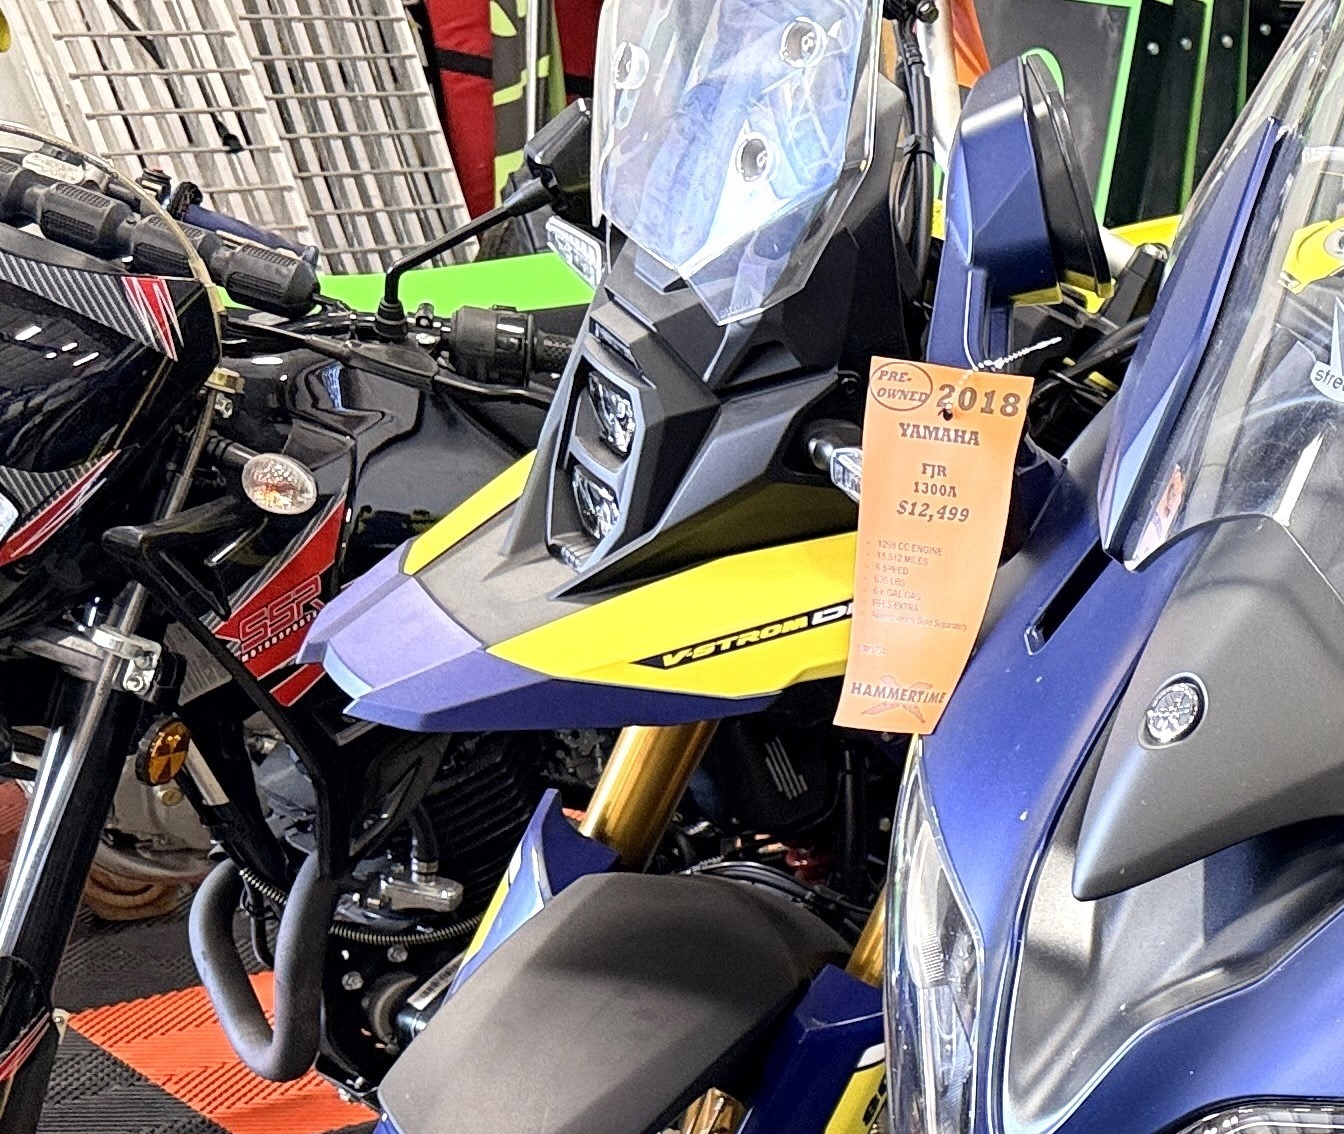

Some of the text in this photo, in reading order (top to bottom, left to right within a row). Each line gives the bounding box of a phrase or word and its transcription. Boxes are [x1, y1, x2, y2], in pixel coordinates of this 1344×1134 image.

[877, 369, 912, 384] PRE-
[876, 387, 930, 403] OWNED
[936, 384, 1021, 417] 2018
[899, 422, 980, 446] YAMAHA
[921, 462, 947, 479] FJR
[913, 481, 957, 498] 1300A
[896, 499, 970, 523] $12,499
[898, 542, 910, 552] CC
[911, 544, 944, 557] ENGINE
[904, 555, 929, 567] MILES
[882, 564, 909, 576] SPEED
[886, 588, 903, 599] GAL
[904, 590, 921, 602] GAS
[893, 601, 920, 613] EXTRA
[661, 616, 809, 668] V-STROM
[850, 681, 948, 705] HAMMERTIME
